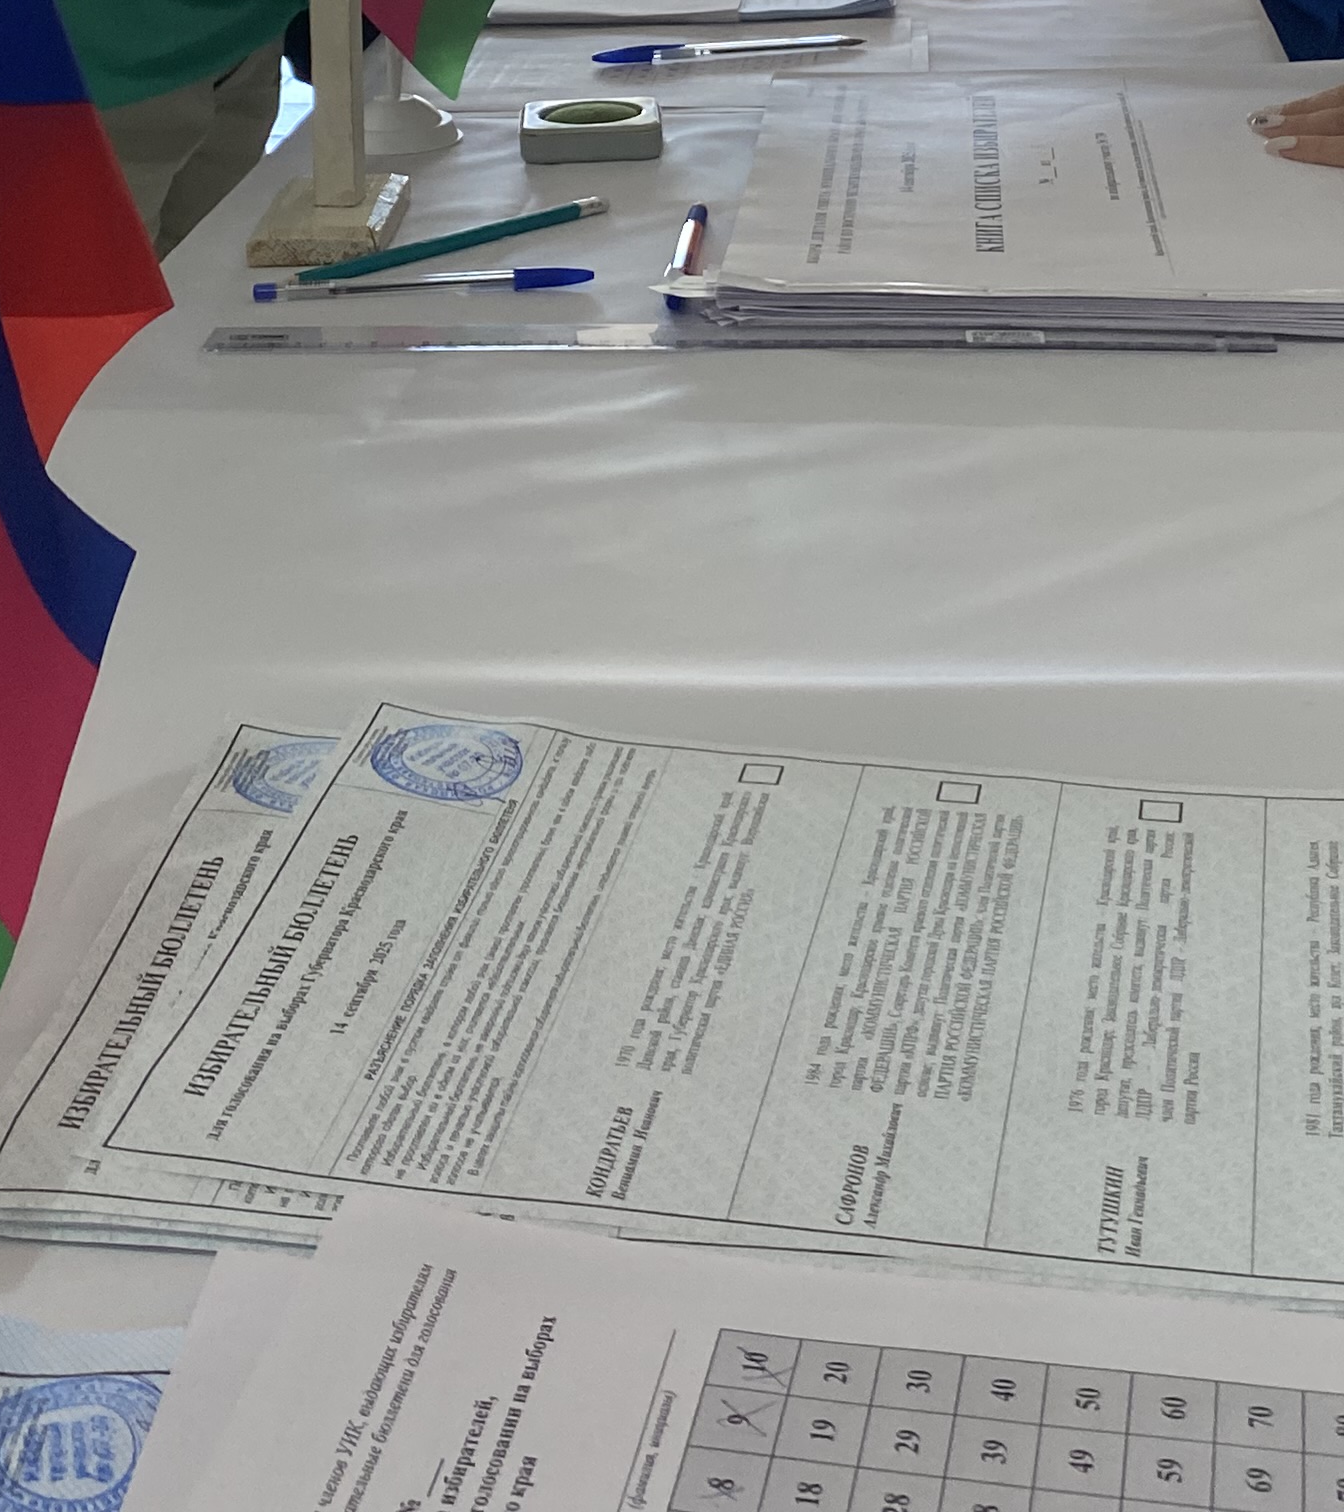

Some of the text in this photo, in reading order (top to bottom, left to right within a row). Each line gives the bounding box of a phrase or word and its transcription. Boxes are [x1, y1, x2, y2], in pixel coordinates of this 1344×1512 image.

[966, 95, 1004, 252] КНИГА СПИСКА ИЗБИРАТЕЛЕЙ
[252, 829, 274, 854] края
[988, 872, 1015, 934] РОССИЙСКОЙ
[56, 856, 225, 1130] ИЗБИРАТЕЛЬНЫЙ БЮЛЛЕТЕНЬ
[182, 834, 359, 1097] ИЗБИРАТЕЛЬНЫЙ БЮЛЛЕТЕНЬ
[205, 809, 409, 1140] для голосования на выборах Губернатора Краснодарского края
[329, 919, 407, 1035] 14 сентября 2025 года
[363, 1015, 408, 1080] РАЗЪЯСНЕНИЕ
[399, 972, 429, 1011] ПОРЯДКА
[422, 915, 459, 969] ЗАПОЛНЕНИЯ
[452, 846, 496, 913] ИЗБИРАТЕЛЬНОГО
[980, 937, 1002, 975] ПАРТИЯ
[614, 1045, 636, 1067] 1970
[804, 1035, 832, 1084] 1984 года
[933, 982, 973, 1099] ПАРТИЯ РОССИЙСКОЙ
[956, 979, 994, 1102] «КОММУНИСТИЧЕСКАЯ
[1068, 1060, 1089, 1113] 1976 года
[1134, 1087, 1154, 1119] ЛДПР
[1305, 1081, 1321, 1137] 1981 года
[585, 1106, 634, 1198] КОНДРАТЬЕВ
[610, 1089, 664, 1200] Вениамин Иванович
[834, 1144, 870, 1225] САФРОНОВ
[862, 1102, 904, 1229] Александр Михайлович
[1097, 1165, 1125, 1254] ТУТУШКИН
[1124, 1155, 1150, 1257] Иван Геннадьевич
[317, 1263, 435, 1506] членов УИК, выдающих избирателям
[370, 1368, 416, 1442] бюллетени
[402, 1344, 426, 1367] для
[417, 1267, 458, 1342] голосования
[521, 1315, 558, 1380] выборах
[906, 1370, 932, 1393] 30
[512, 1384, 532, 1403] на
[796, 1361, 851, 1506] 18 19 20
[981, 1378, 1017, 1463] 39 40
[1070, 1388, 1101, 1473] 49 50
[440, 1395, 500, 1504] избирателей,
[510, 1456, 539, 1496] края
[895, 1429, 921, 1454] 29
[1157, 1396, 1188, 1483] 59 60
[1247, 1406, 1274, 1493] 69 70
